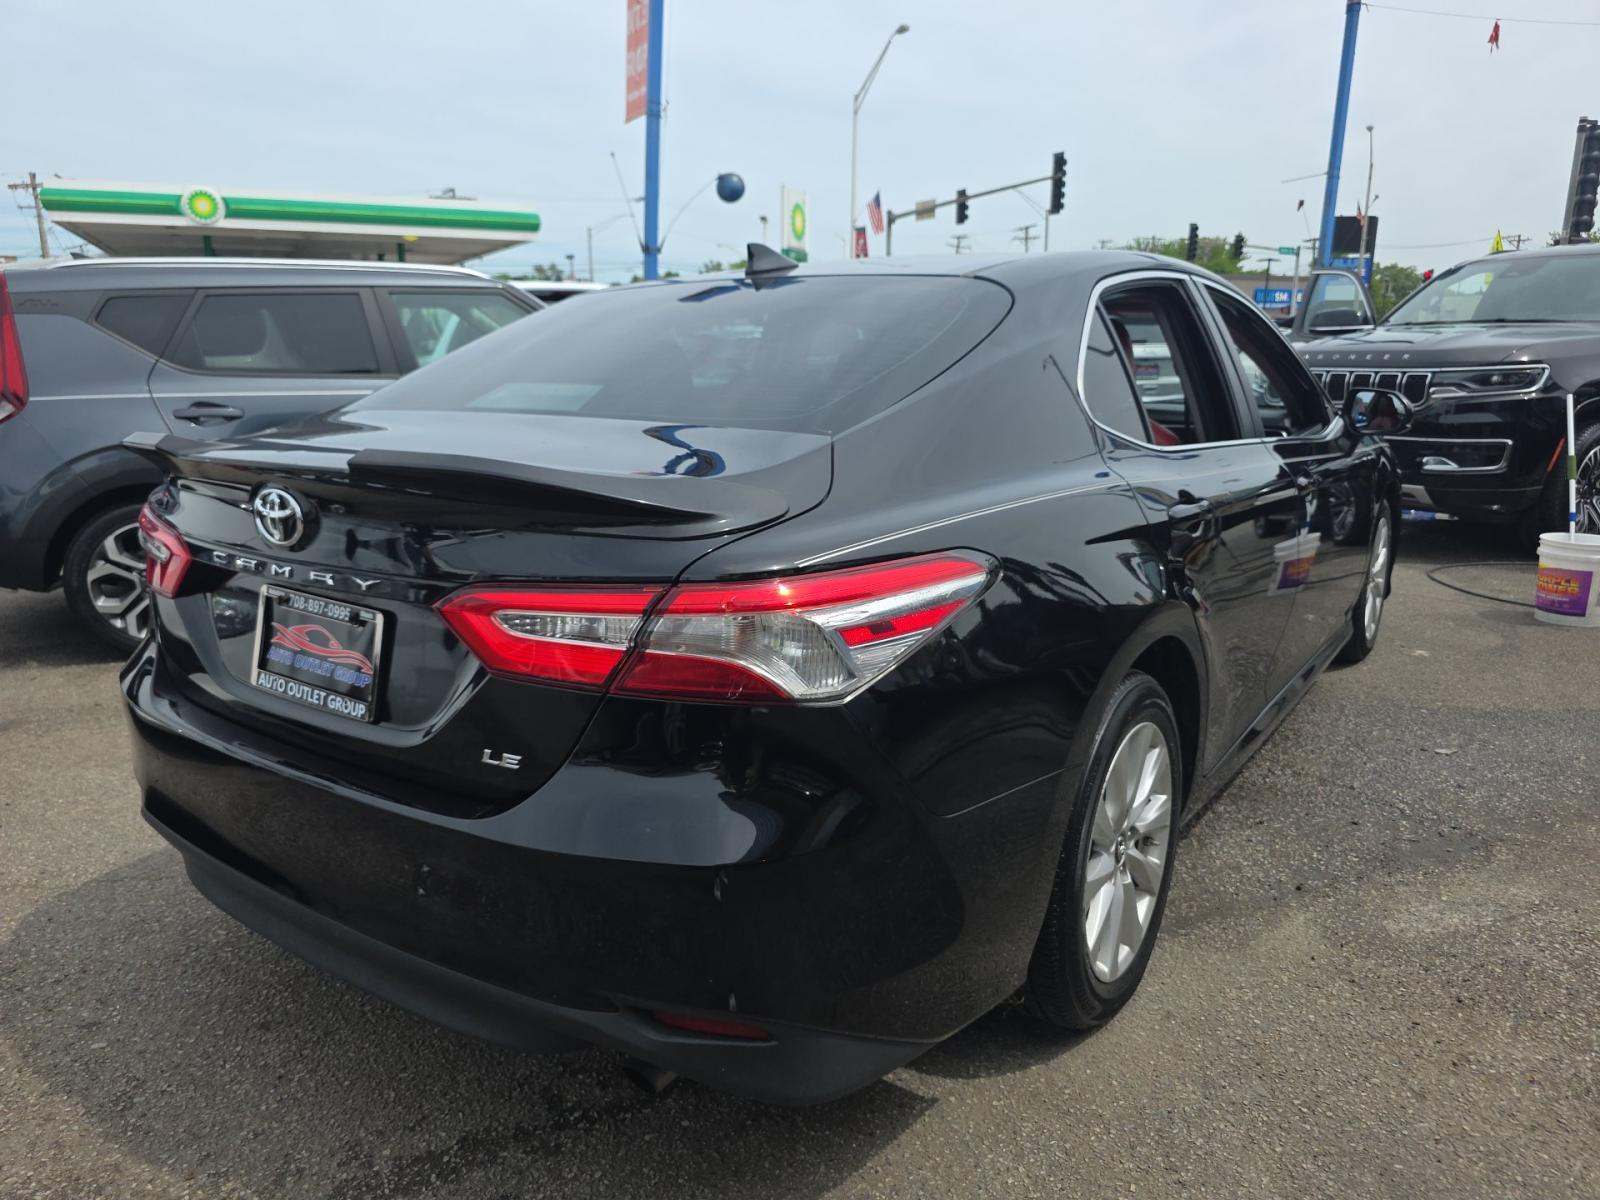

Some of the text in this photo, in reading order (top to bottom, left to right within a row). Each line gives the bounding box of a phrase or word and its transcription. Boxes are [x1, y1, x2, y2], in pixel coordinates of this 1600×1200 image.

[212, 550, 382, 591] CAMRY
[288, 593, 352, 621] 708-897-0995
[267, 645, 374, 688] AUTO OUTLET GROUP
[258, 672, 366, 719] AUTO OUTLET GROUP
[481, 748, 522, 769] LE
